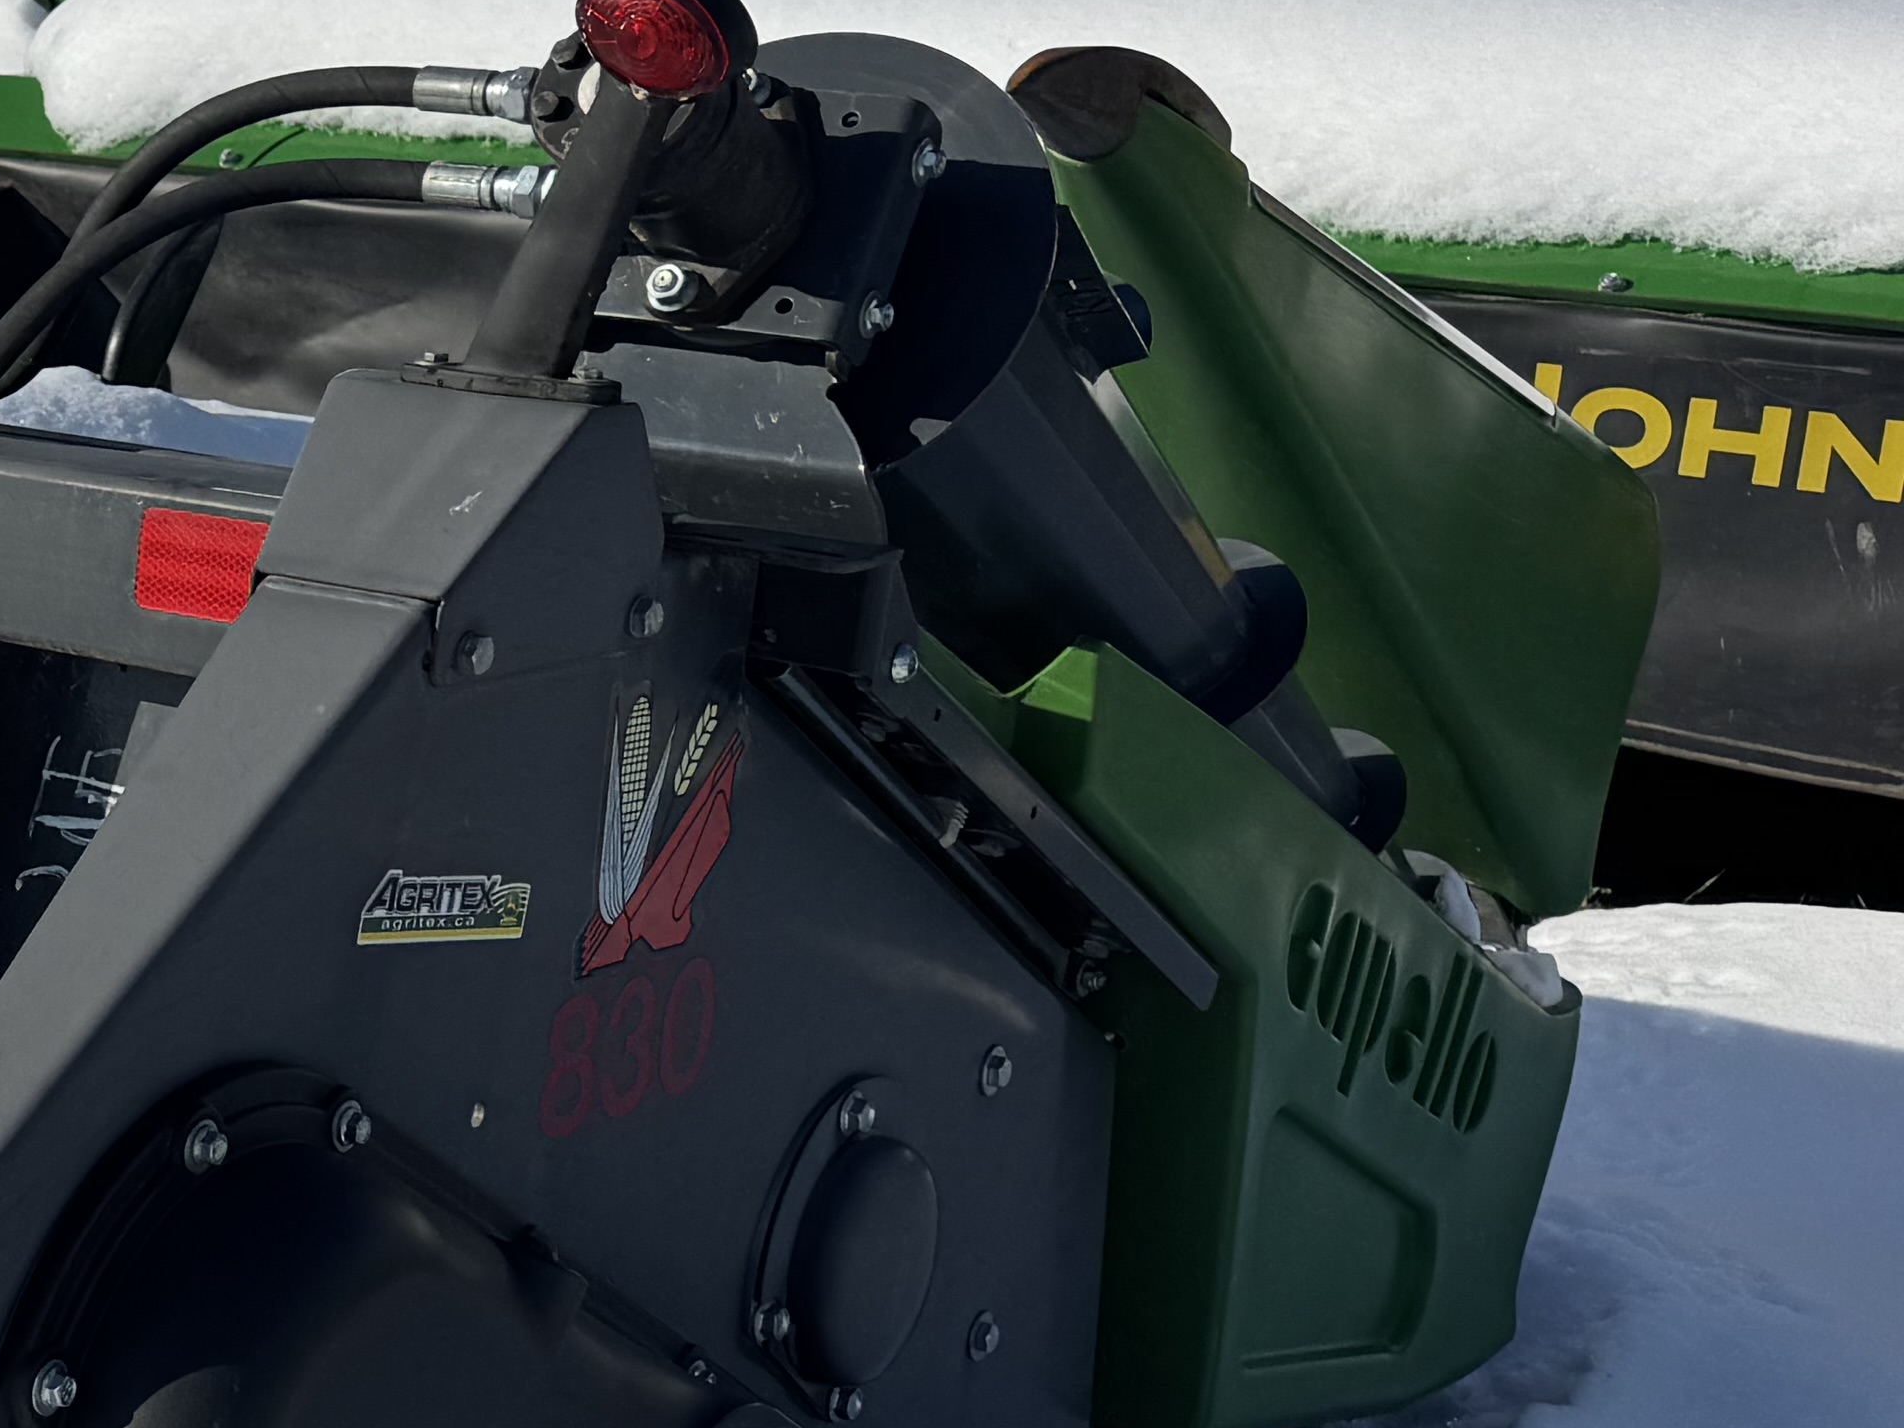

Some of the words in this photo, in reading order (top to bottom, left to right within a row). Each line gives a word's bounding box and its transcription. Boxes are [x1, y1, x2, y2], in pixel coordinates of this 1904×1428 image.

[363, 870, 500, 914] AGRITEX
[381, 916, 475, 931] agritex.ca
[538, 957, 714, 1138] 830
[1287, 883, 1497, 1135] capello
